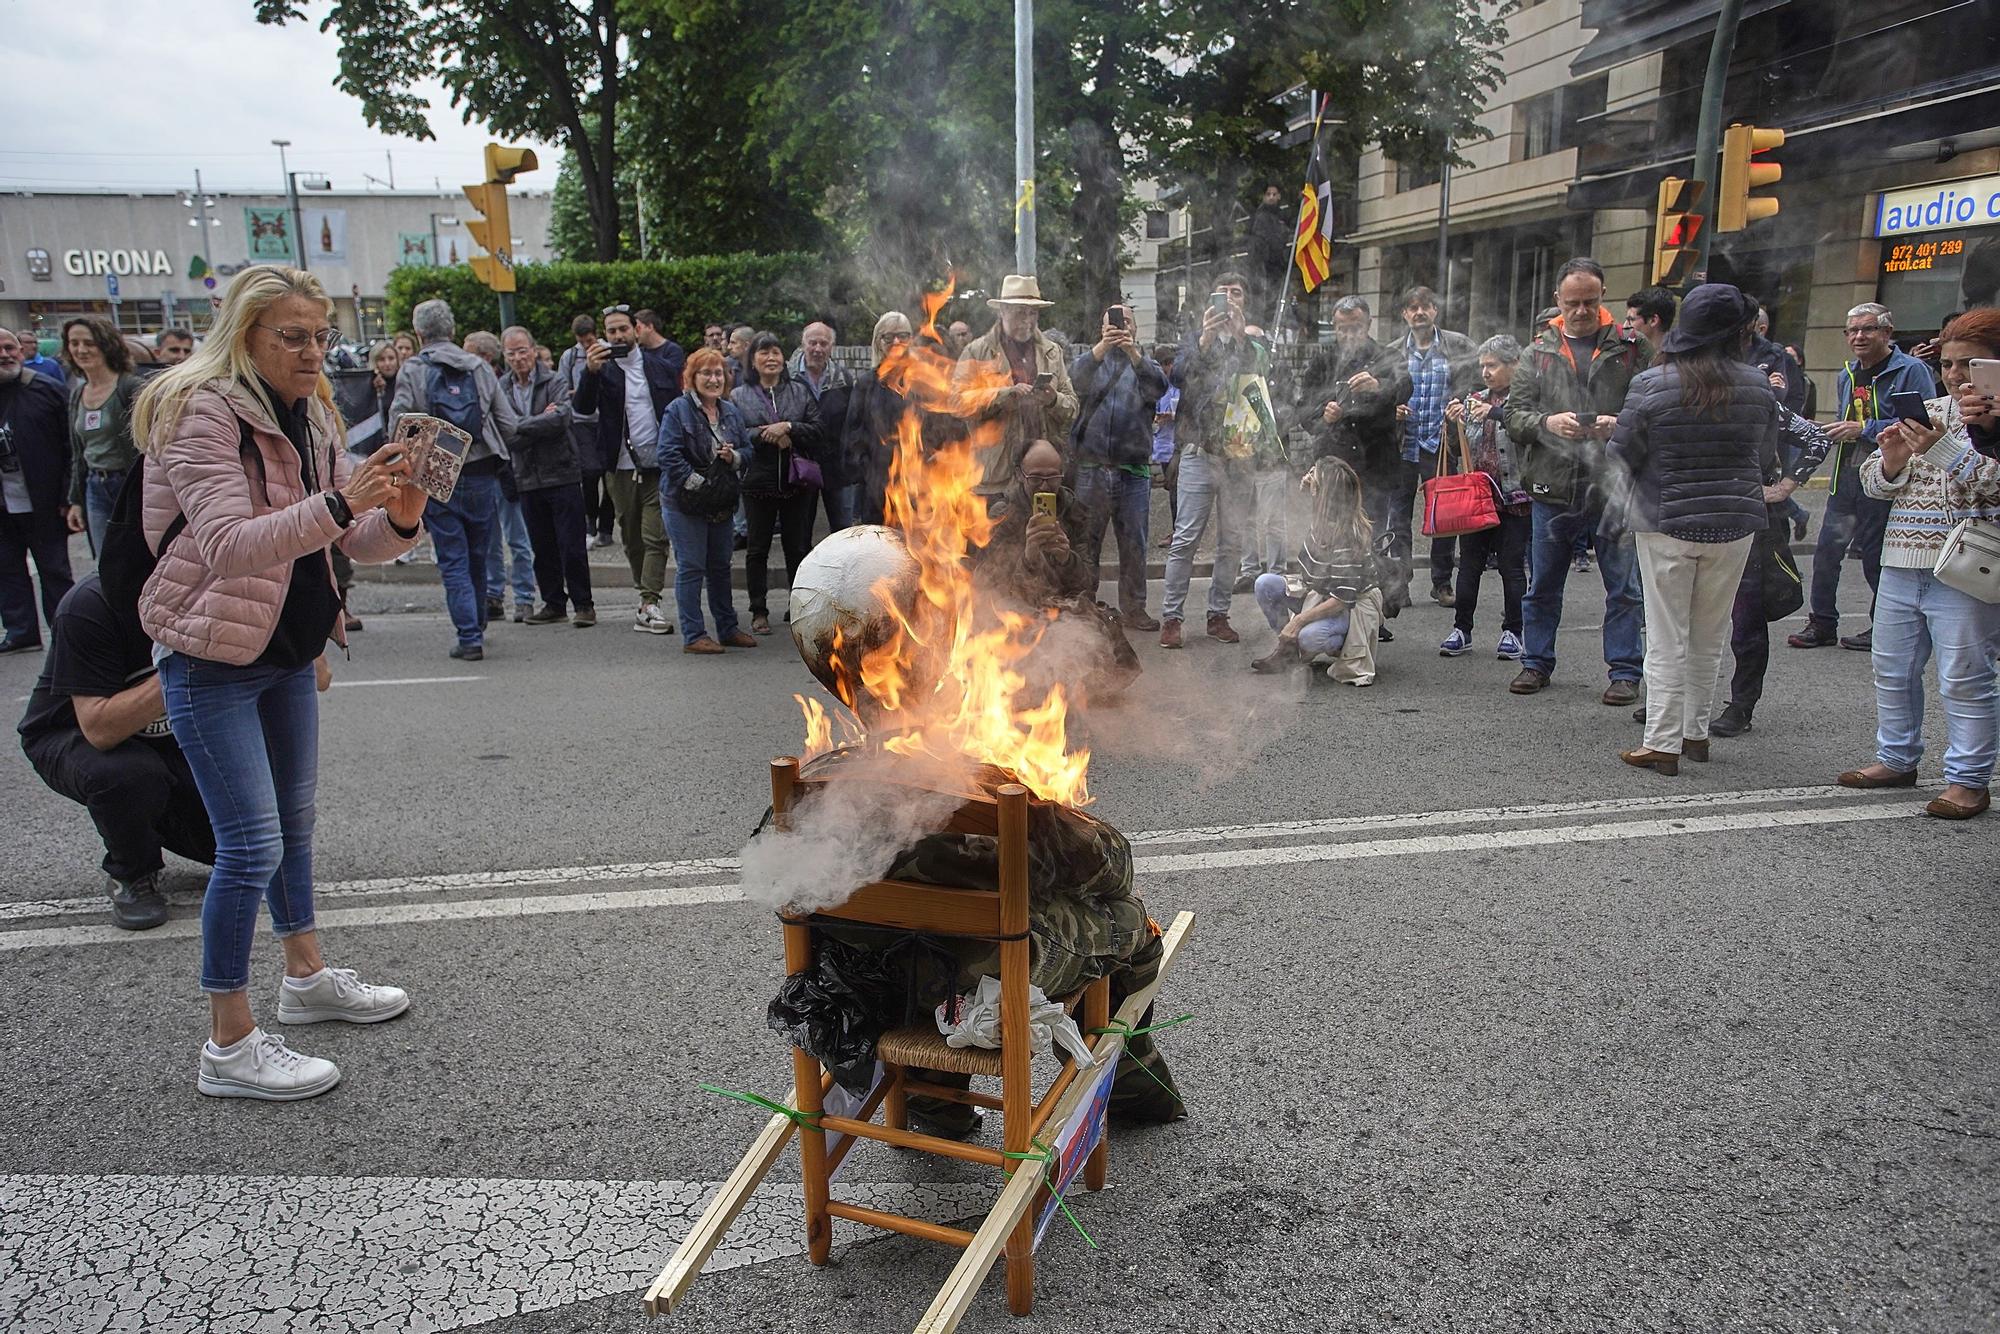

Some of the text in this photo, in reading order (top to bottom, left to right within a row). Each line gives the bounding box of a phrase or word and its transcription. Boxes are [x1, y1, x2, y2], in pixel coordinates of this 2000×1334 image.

[1886, 191, 1976, 231] audio
[64, 249, 173, 276] GIRONA
[1892, 240, 1963, 260] 972 401 289
